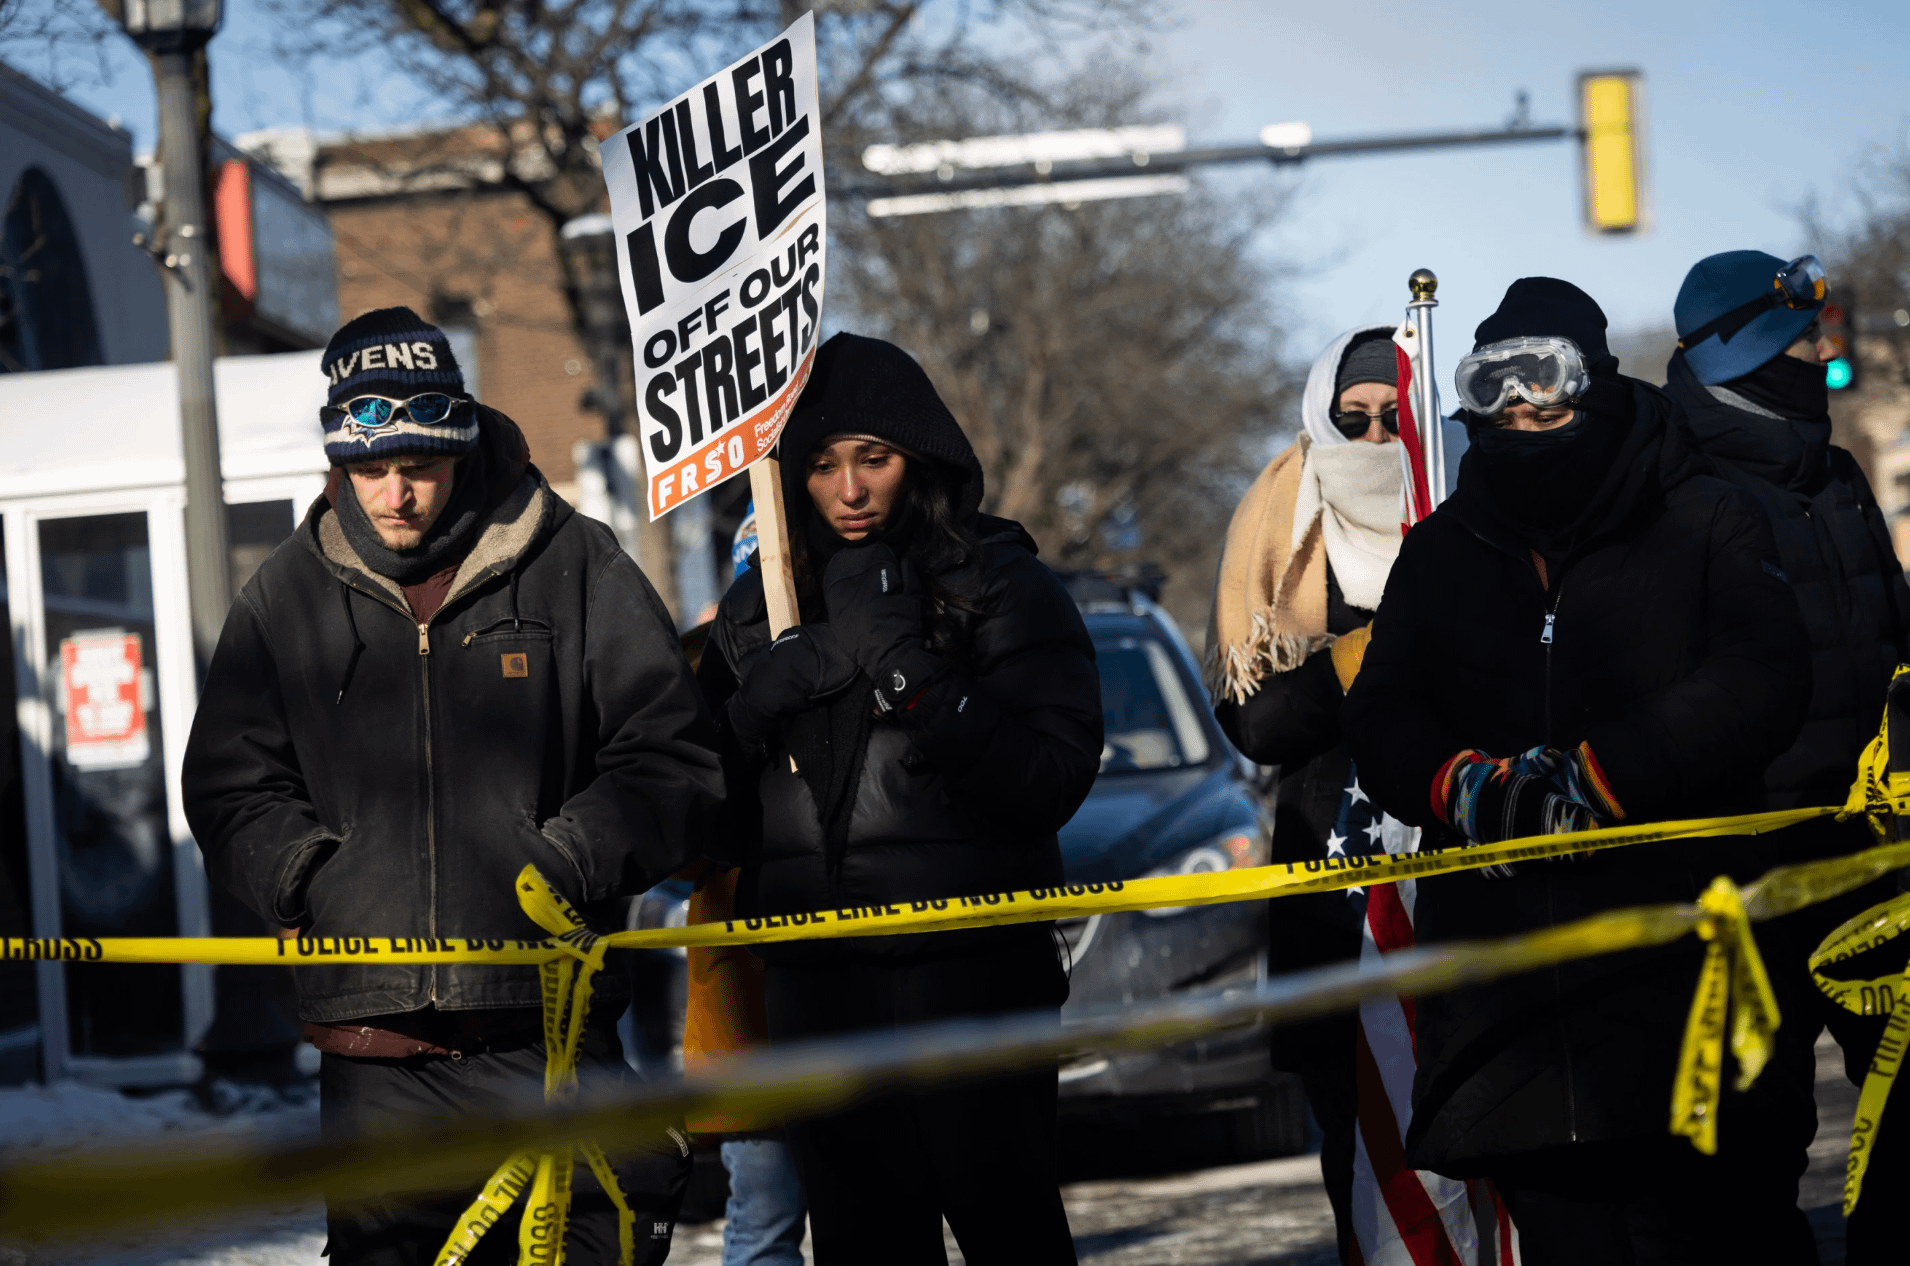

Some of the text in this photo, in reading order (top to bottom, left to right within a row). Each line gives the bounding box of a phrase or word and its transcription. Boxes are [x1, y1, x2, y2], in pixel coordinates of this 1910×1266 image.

[626, 38, 796, 222] KILLER
[626, 113, 817, 317] ICE
[643, 288, 731, 369] OFF
[739, 222, 820, 309] OUR
[645, 262, 820, 464] STREETS
[754, 401, 786, 438] Freedom
[657, 434, 745, 511] FRSO
